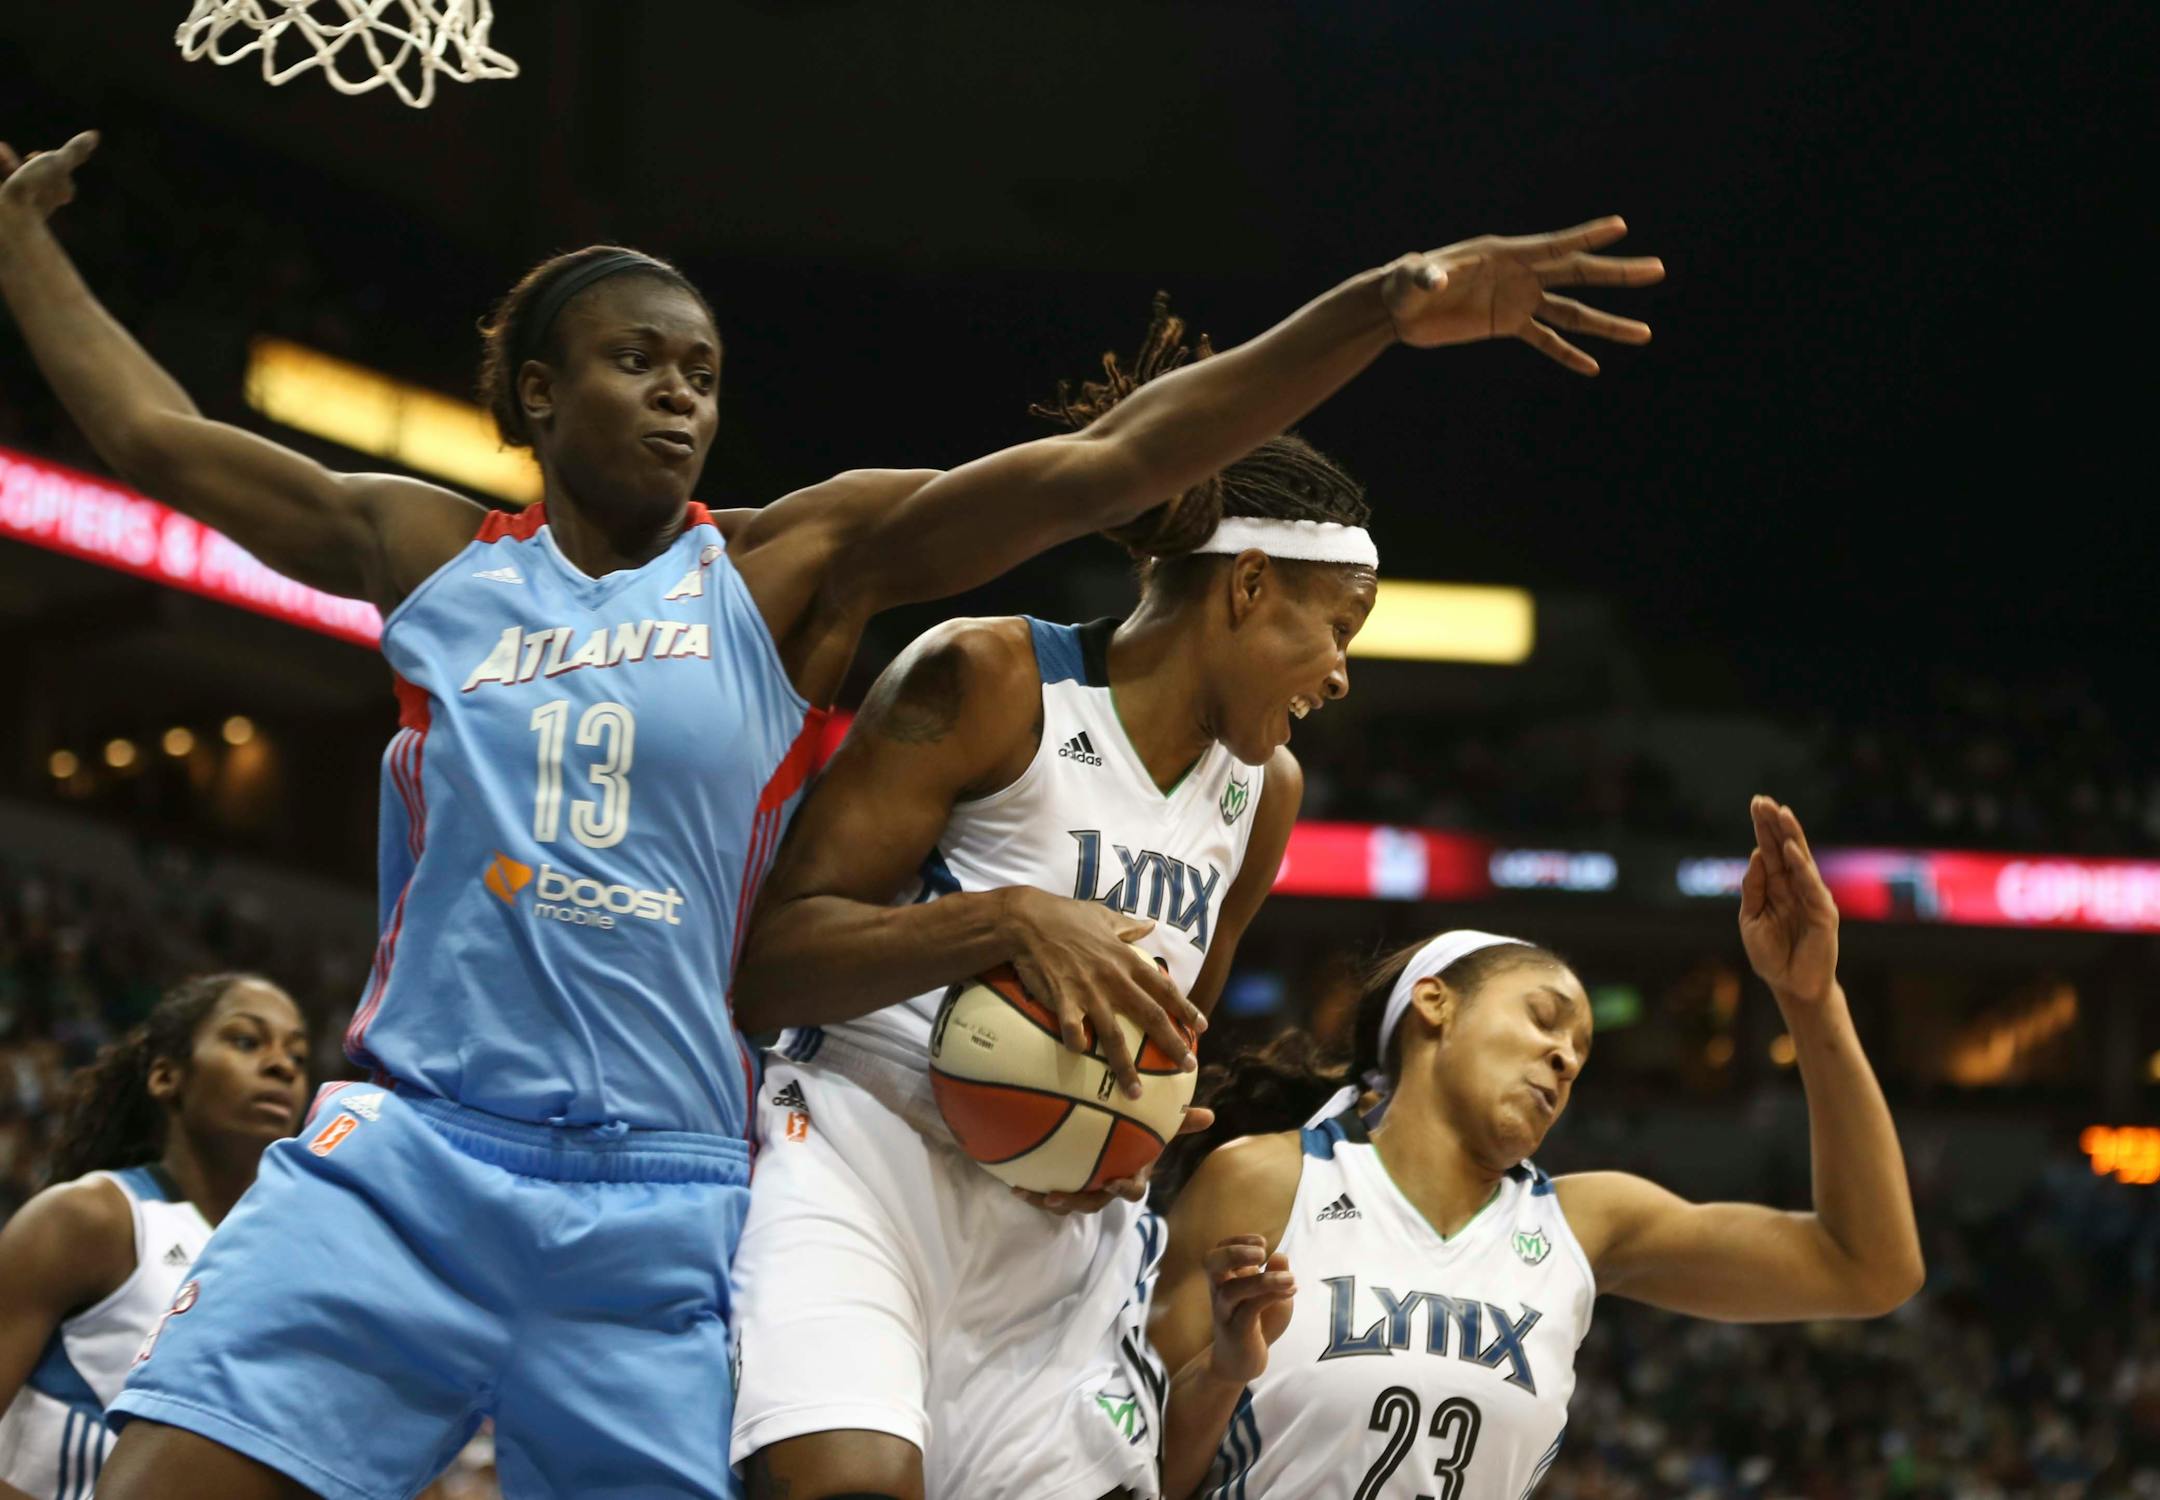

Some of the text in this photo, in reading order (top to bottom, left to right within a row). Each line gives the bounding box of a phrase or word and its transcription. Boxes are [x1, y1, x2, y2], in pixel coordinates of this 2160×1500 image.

[460, 619, 711, 694] ATLANTA
[529, 699, 637, 850] 13
[533, 900, 616, 931] mobile
[536, 863, 685, 926] boost
[1066, 829, 1221, 956] LYNX
[1317, 1275, 1543, 1398] LYNX
[1352, 1385, 1483, 1500] 23
